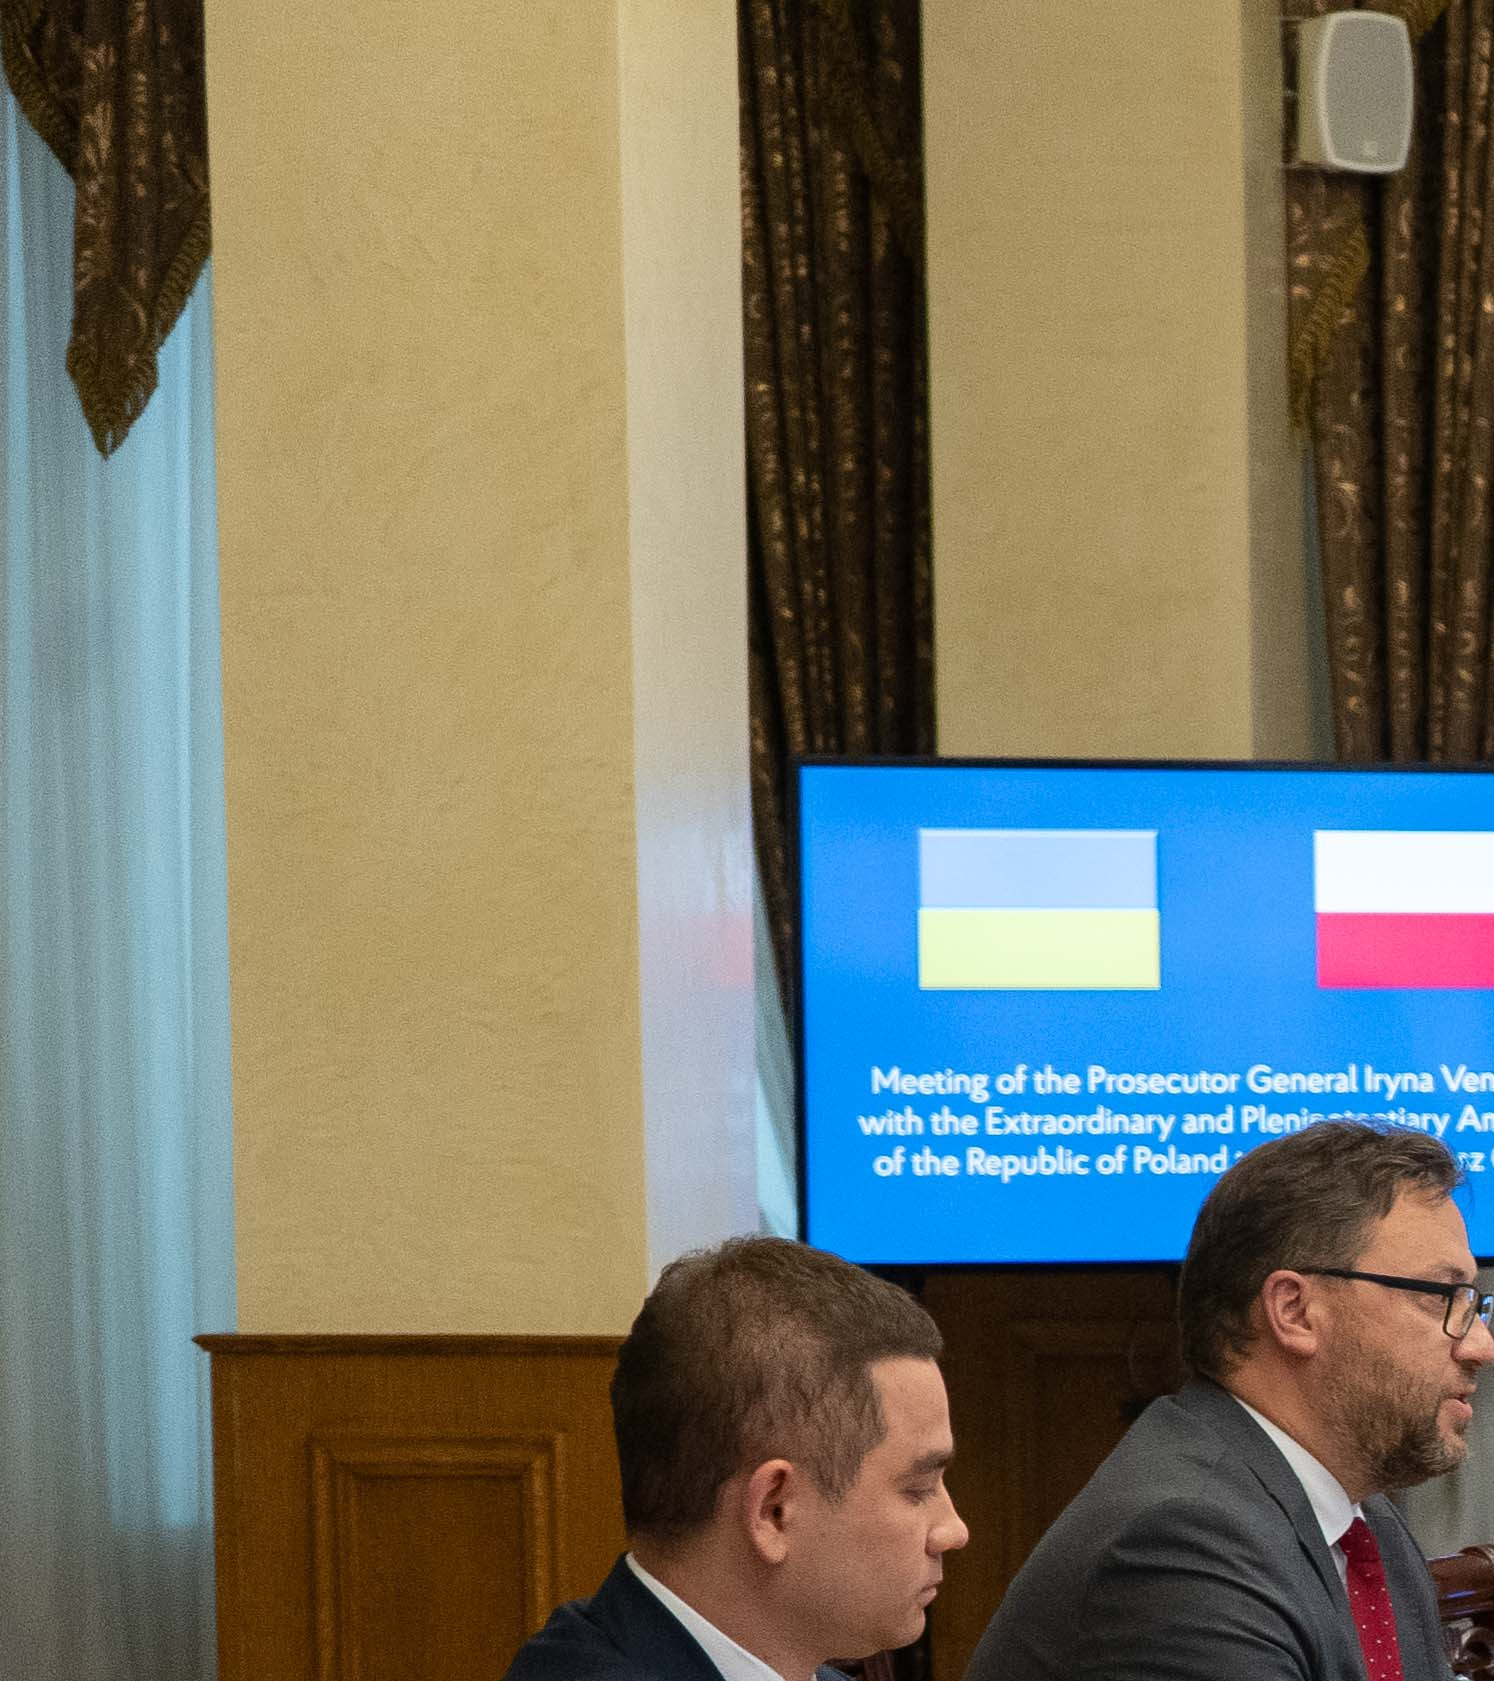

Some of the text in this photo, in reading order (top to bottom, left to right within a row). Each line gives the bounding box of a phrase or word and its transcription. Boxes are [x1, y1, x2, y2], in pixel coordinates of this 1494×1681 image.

[871, 1064, 990, 1103] Meeting
[995, 1063, 1028, 1094] of
[1033, 1063, 1081, 1094] the
[1087, 1065, 1240, 1094] Prosecutor
[1246, 1064, 1358, 1093] General
[1364, 1065, 1434, 1101] Iryna
[857, 1105, 924, 1136] with
[930, 1105, 979, 1135] the
[984, 1104, 1175, 1142] Extraordinary
[1181, 1105, 1234, 1135] and
[873, 1146, 905, 1177] of
[911, 1146, 959, 1176] the
[966, 1146, 1090, 1184] Republic
[1096, 1144, 1128, 1175] of
[1133, 1145, 1229, 1175] Poland
